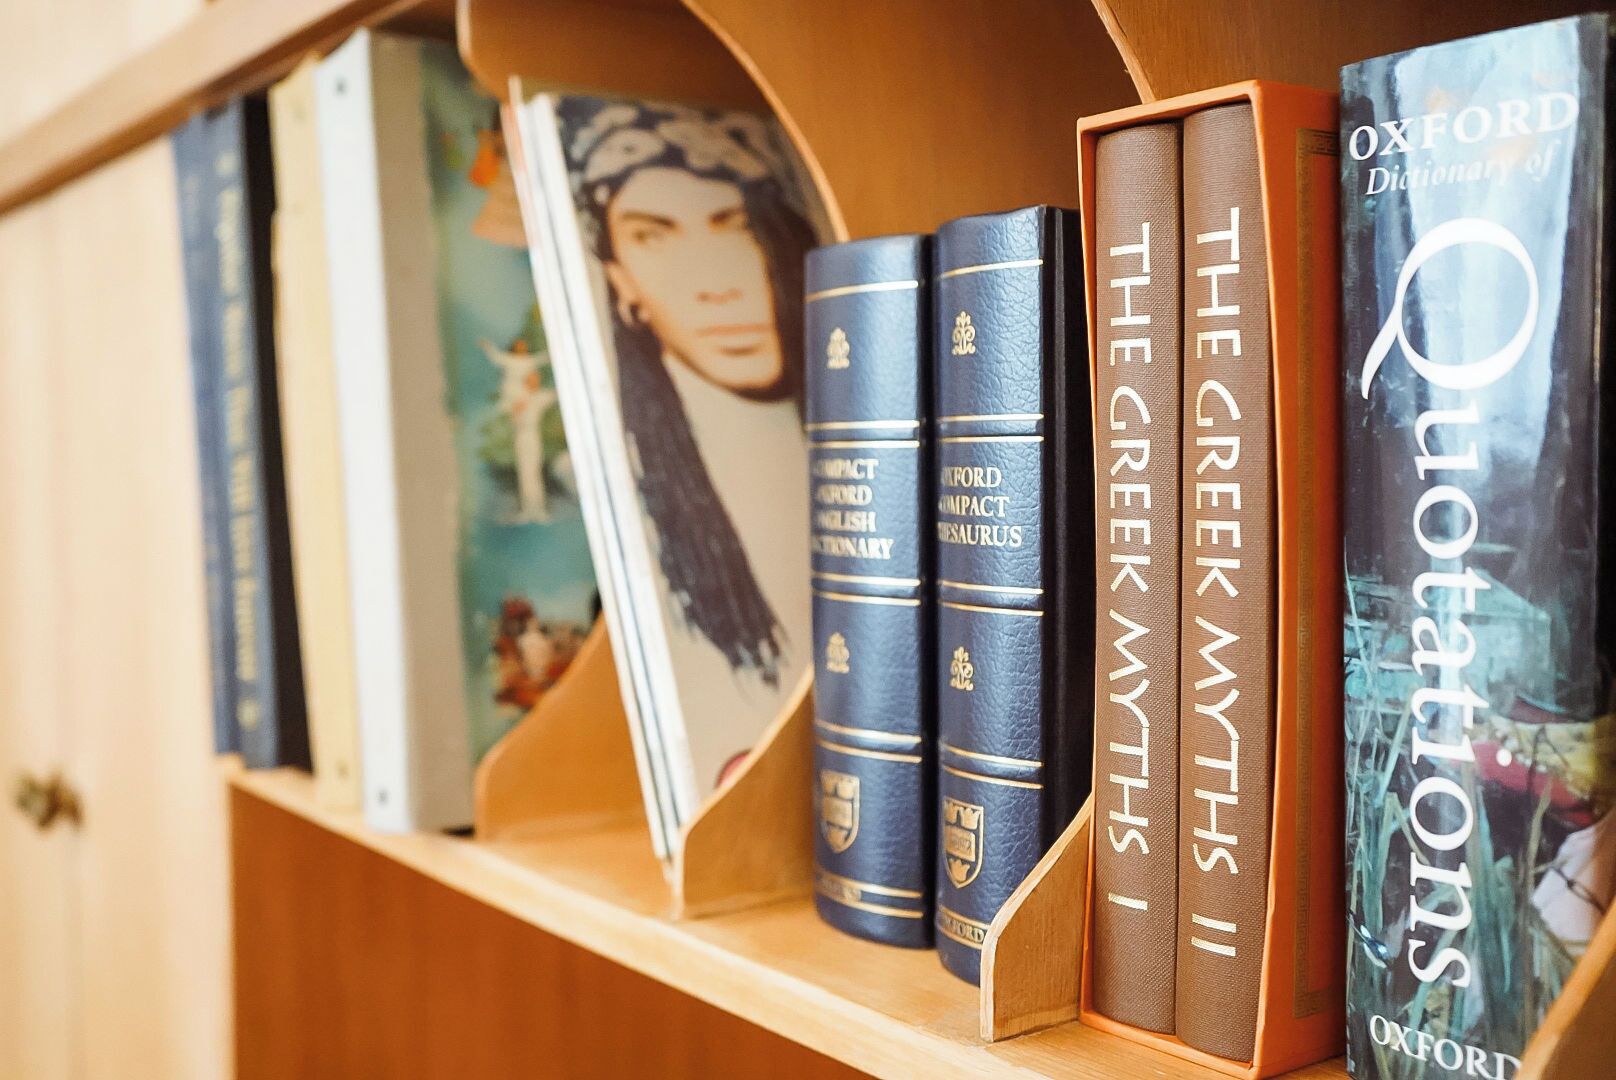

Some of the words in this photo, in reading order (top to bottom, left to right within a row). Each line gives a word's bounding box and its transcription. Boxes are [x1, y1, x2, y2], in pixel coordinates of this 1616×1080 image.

[1349, 91, 1580, 161] OXFORD
[1365, 154, 1514, 195] Dictionary
[1525, 139, 1562, 182] of
[1109, 222, 1152, 366] THE
[1196, 206, 1242, 359] THE
[1109, 385, 1152, 593] GREEK
[1195, 379, 1242, 598] GREEK
[1361, 217, 1540, 988] Quotations
[1107, 608, 1151, 855] MYTHS
[1193, 615, 1241, 875] MYTHS
[1107, 892, 1149, 911] I
[1191, 912, 1237, 957] II
